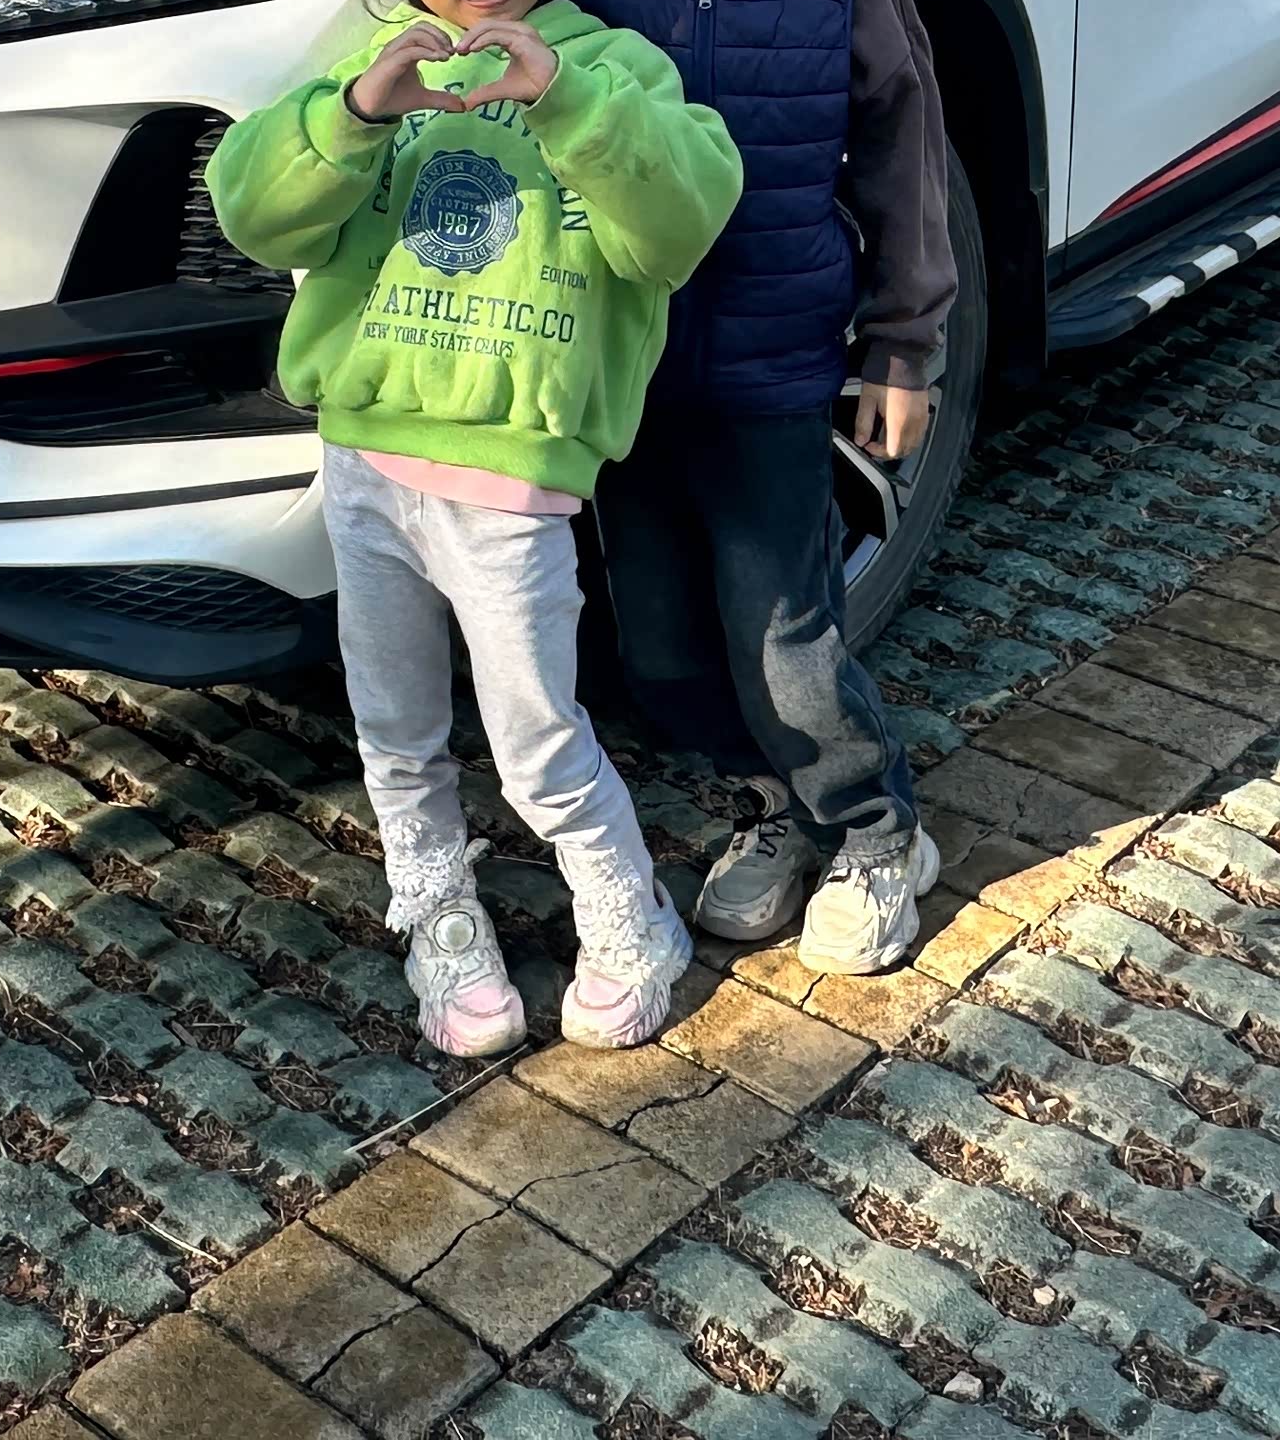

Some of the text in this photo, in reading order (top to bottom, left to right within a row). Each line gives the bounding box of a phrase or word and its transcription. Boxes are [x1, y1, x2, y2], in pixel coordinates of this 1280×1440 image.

[436, 210, 481, 238] 1987
[394, 325, 428, 345] YORK
[430, 329, 472, 352] STATE
